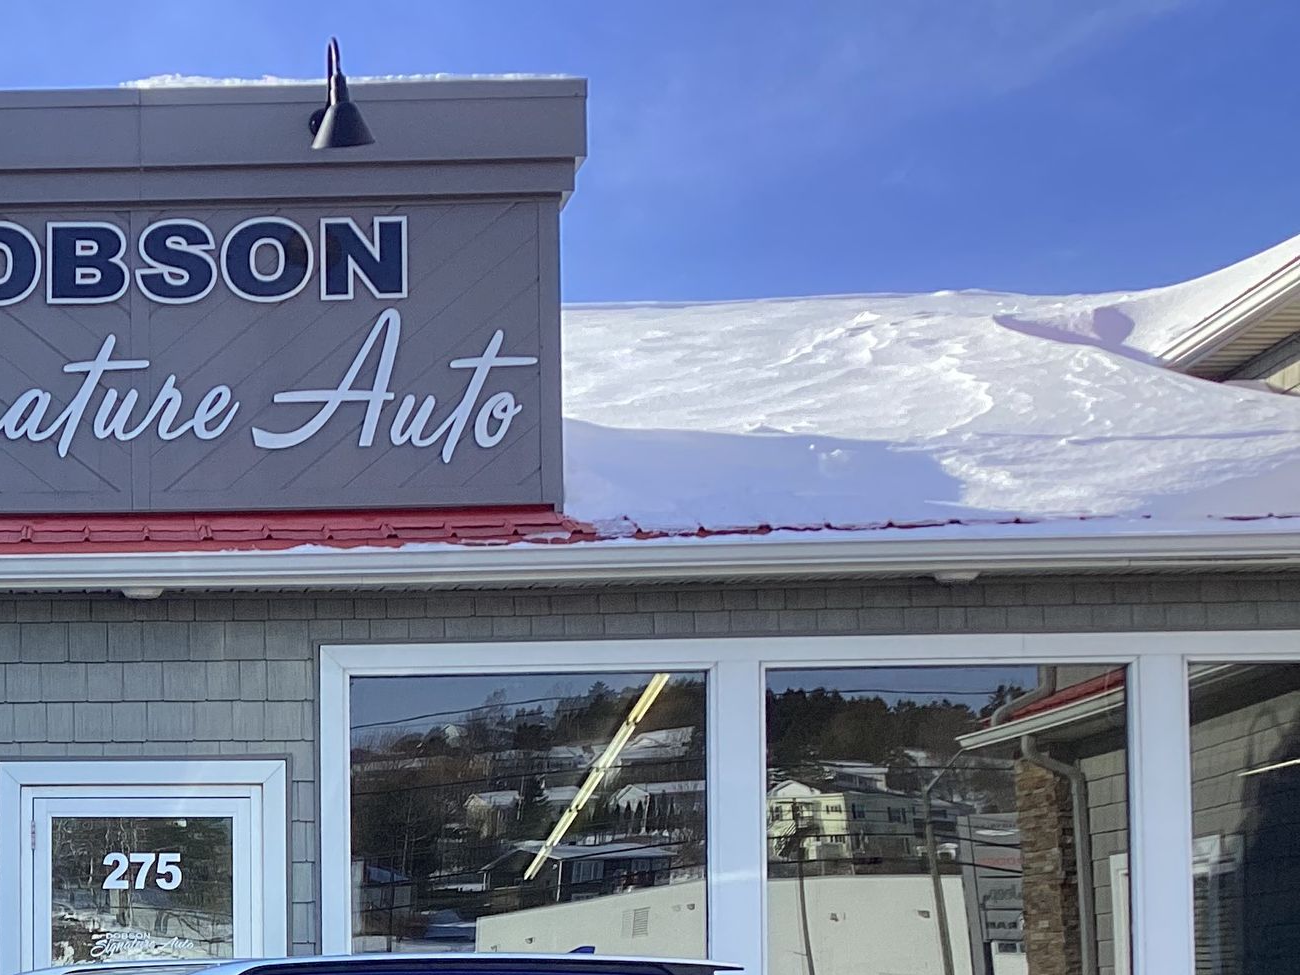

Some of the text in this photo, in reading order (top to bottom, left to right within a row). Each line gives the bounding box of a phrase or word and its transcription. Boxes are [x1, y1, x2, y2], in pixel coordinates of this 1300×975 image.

[252, 308, 538, 464] Auto
[102, 852, 183, 890] 275
[90, 936, 195, 958] Signature Auto
[105, 932, 151, 940] DOBSON
